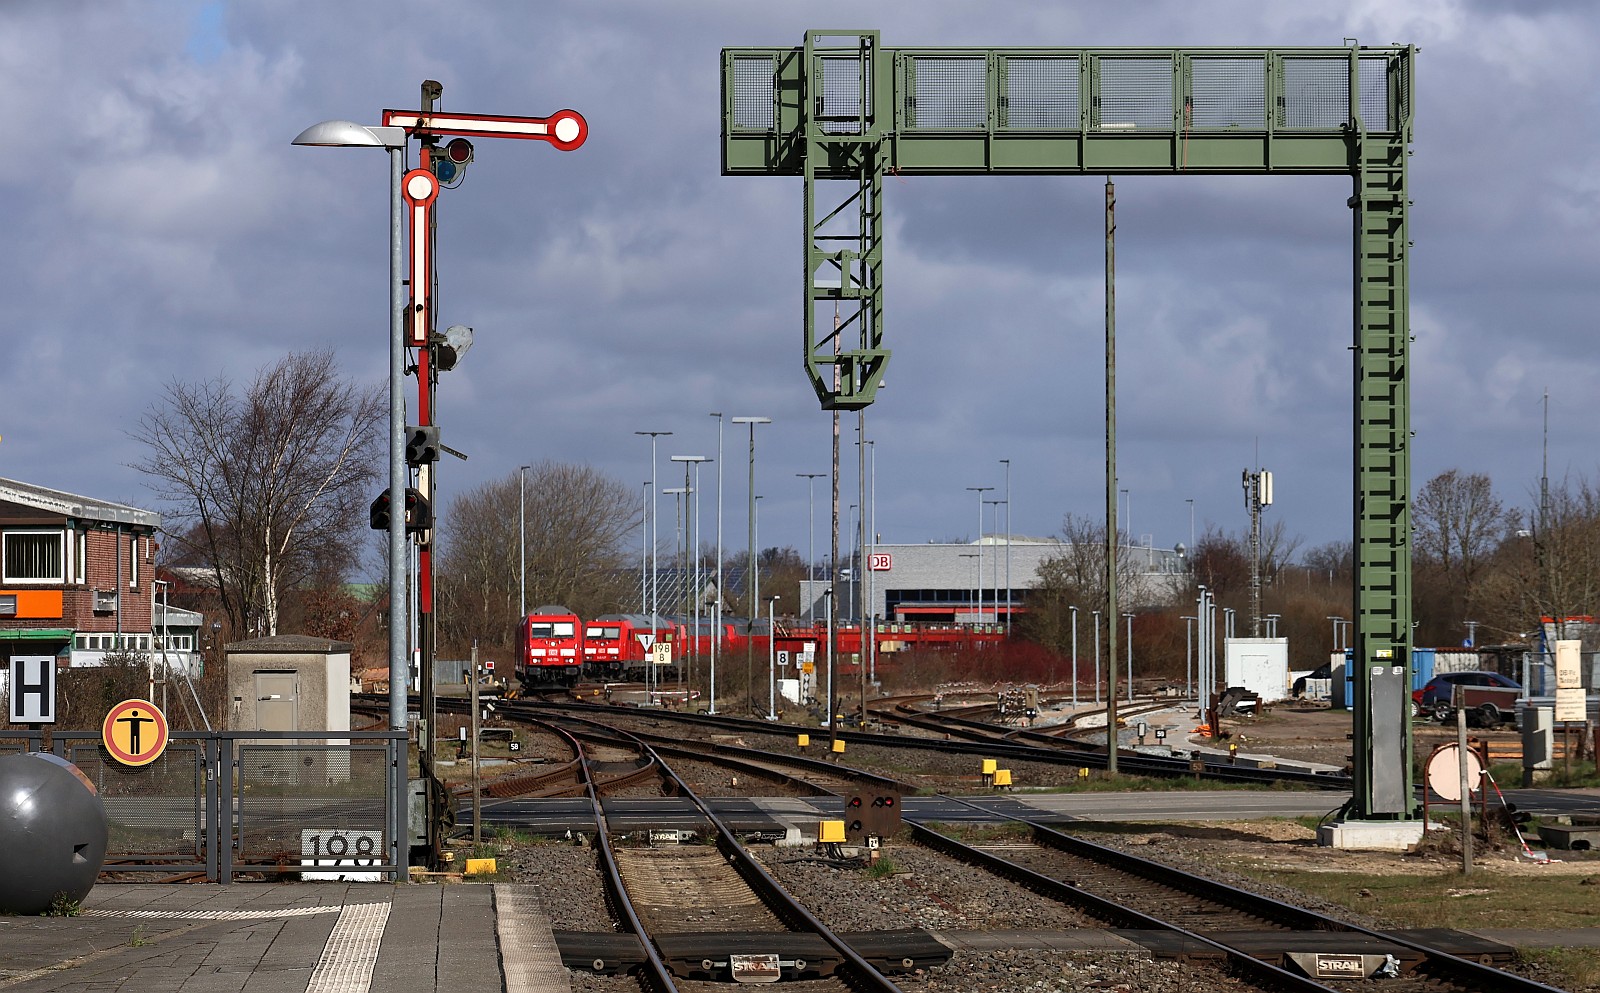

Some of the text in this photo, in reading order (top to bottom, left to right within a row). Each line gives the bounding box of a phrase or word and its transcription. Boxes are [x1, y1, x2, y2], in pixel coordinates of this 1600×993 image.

[644, 635, 649, 645] 1
[654, 644, 670, 653] 198
[659, 653, 665, 662] 8
[780, 653, 786, 663] 8
[15, 660, 50, 717] H
